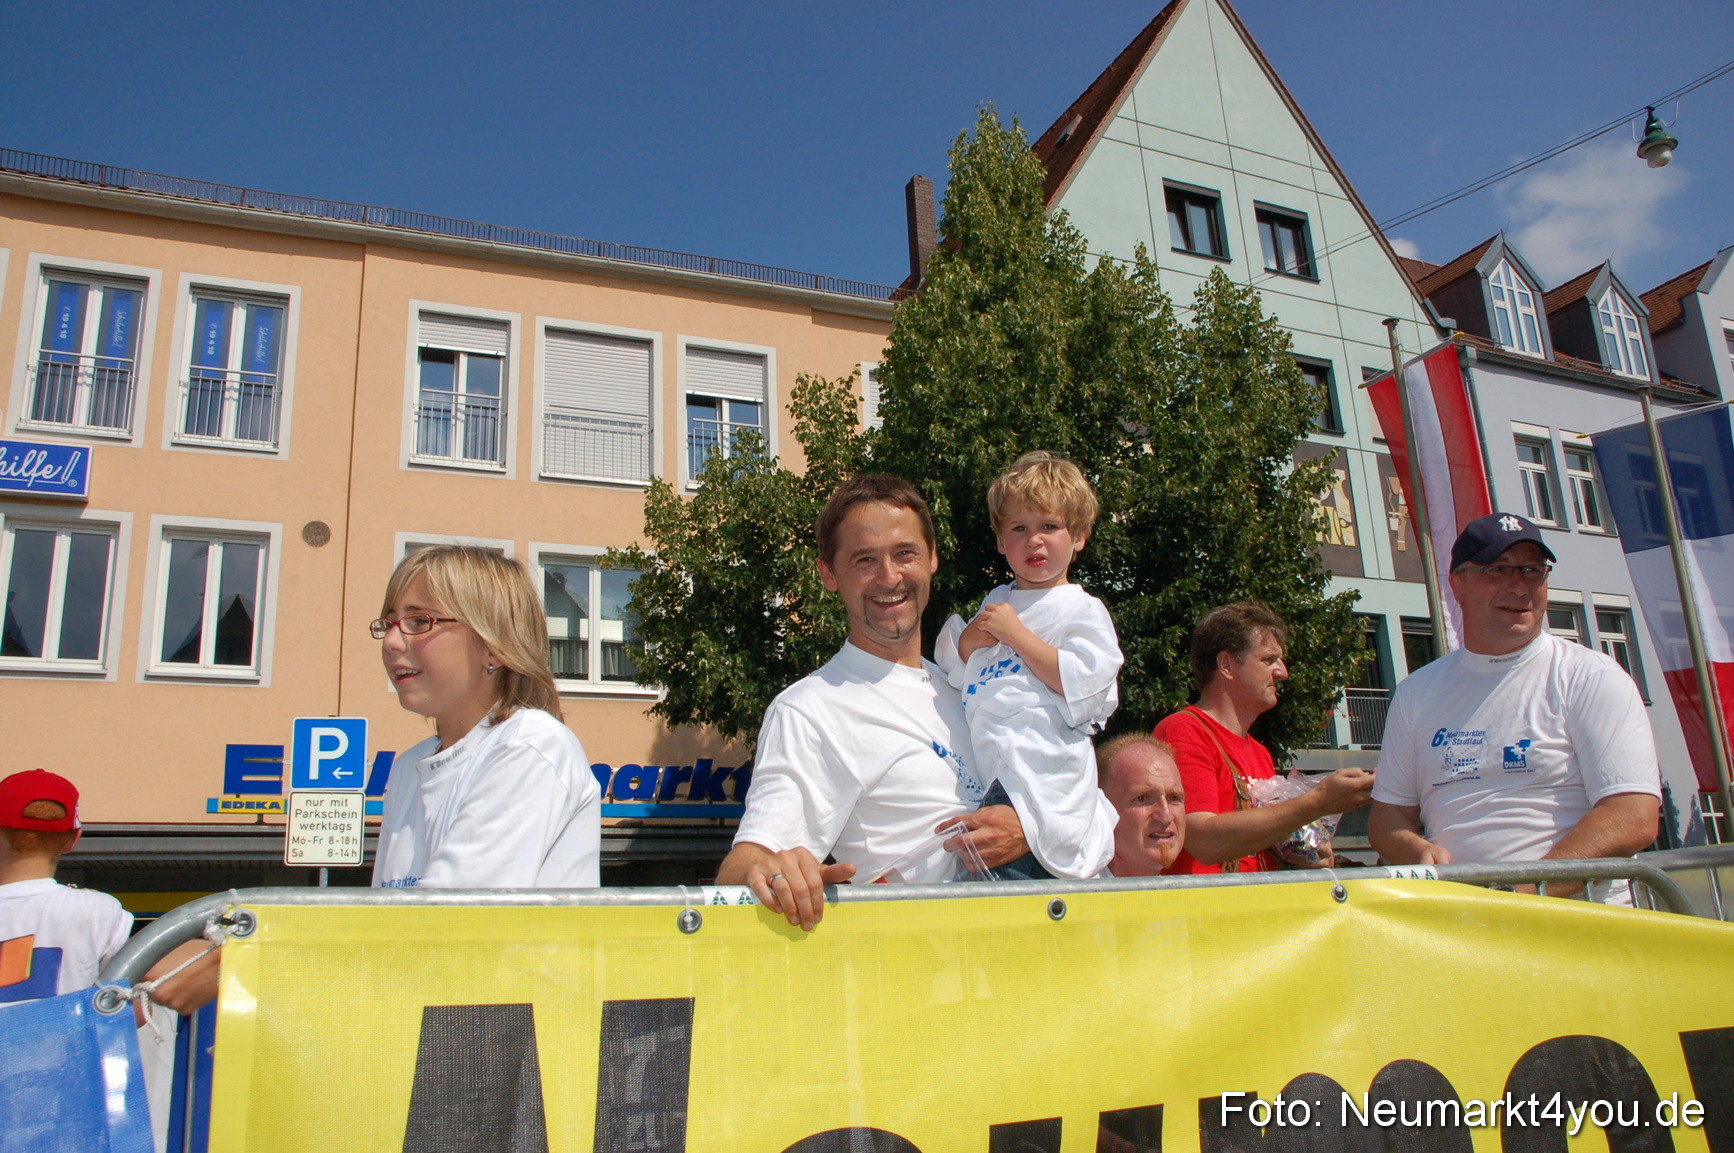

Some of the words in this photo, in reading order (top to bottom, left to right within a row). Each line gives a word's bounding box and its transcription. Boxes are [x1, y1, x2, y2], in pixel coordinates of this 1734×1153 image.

[1431, 728, 1449, 748] 6.
[1451, 737, 1483, 746] Stadtlauf
[309, 727, 349, 780] P
[221, 801, 281, 810] EDEKA
[305, 799, 324, 807] nur
[330, 798, 348, 807] mit
[295, 809, 357, 819] Parkschein
[299, 821, 352, 833] werktags
[291, 849, 304, 858] Sa
